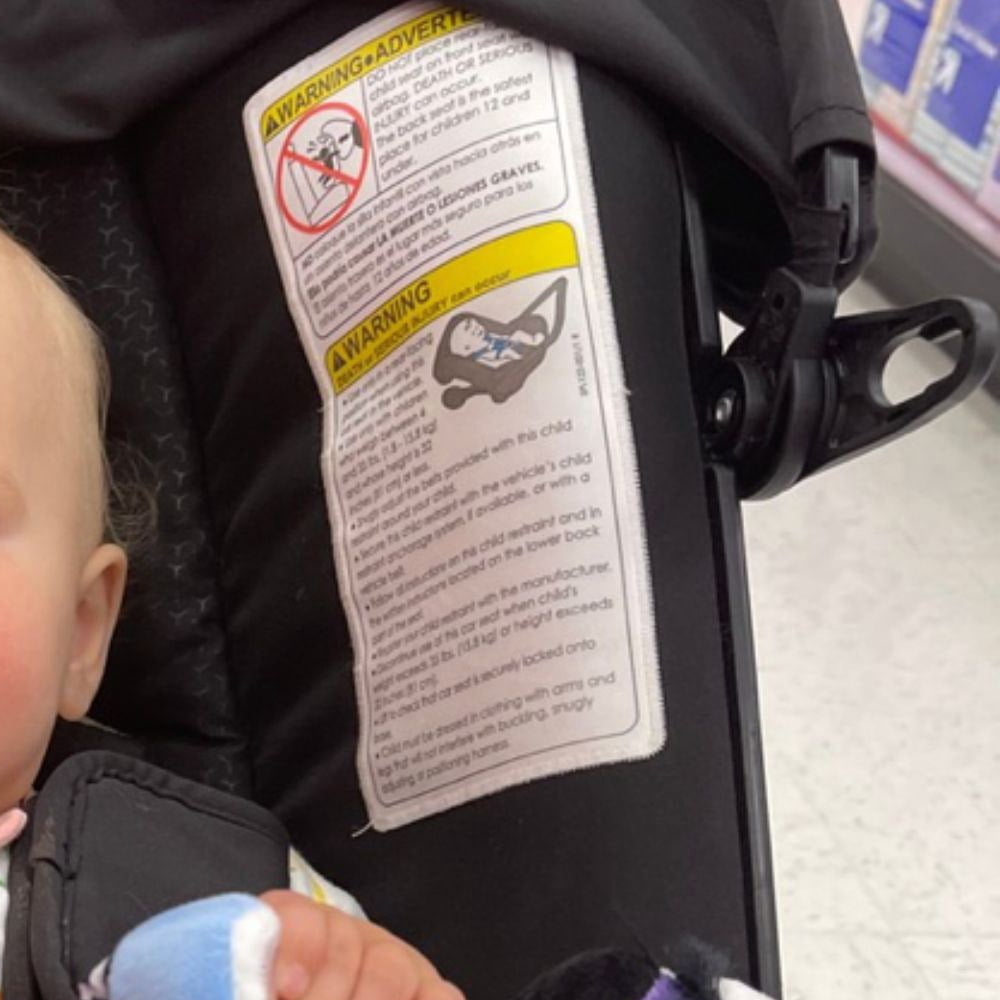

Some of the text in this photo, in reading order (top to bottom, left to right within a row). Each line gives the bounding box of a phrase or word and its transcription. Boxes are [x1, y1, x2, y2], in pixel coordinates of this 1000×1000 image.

[275, 56, 363, 123] WARNING
[369, 79, 396, 101] child
[426, 59, 443, 72] on
[397, 115, 427, 137] back
[429, 98, 456, 120] seat
[469, 85, 491, 102] the
[493, 72, 534, 95] safest
[413, 92, 438, 111] can
[379, 89, 531, 168] place for children 12 and
[453, 147, 487, 169] hacia
[490, 160, 544, 186] GRAVES.
[484, 185, 514, 207] para
[515, 179, 534, 193] los
[450, 286, 472, 303] can
[341, 279, 431, 361] WARNING
[490, 437, 516, 455] with
[540, 418, 574, 437] child
[481, 481, 500, 496] the
[558, 450, 593, 470] child
[532, 472, 591, 496] or with a
[479, 532, 504, 553] child
[558, 508, 586, 526] and
[590, 505, 603, 519] in
[487, 553, 502, 568] on
[504, 545, 523, 560] the
[526, 533, 562, 553] lower
[565, 523, 600, 544] back
[460, 583, 579, 636] car seat when child's
[499, 584, 519, 600] the
[500, 596, 614, 638] or height exceeds
[522, 643, 564, 668] locked
[565, 638, 596, 656] onto
[525, 686, 550, 704] with
[552, 679, 584, 697] arms
[587, 669, 617, 689] and
[551, 696, 596, 717] snugly
